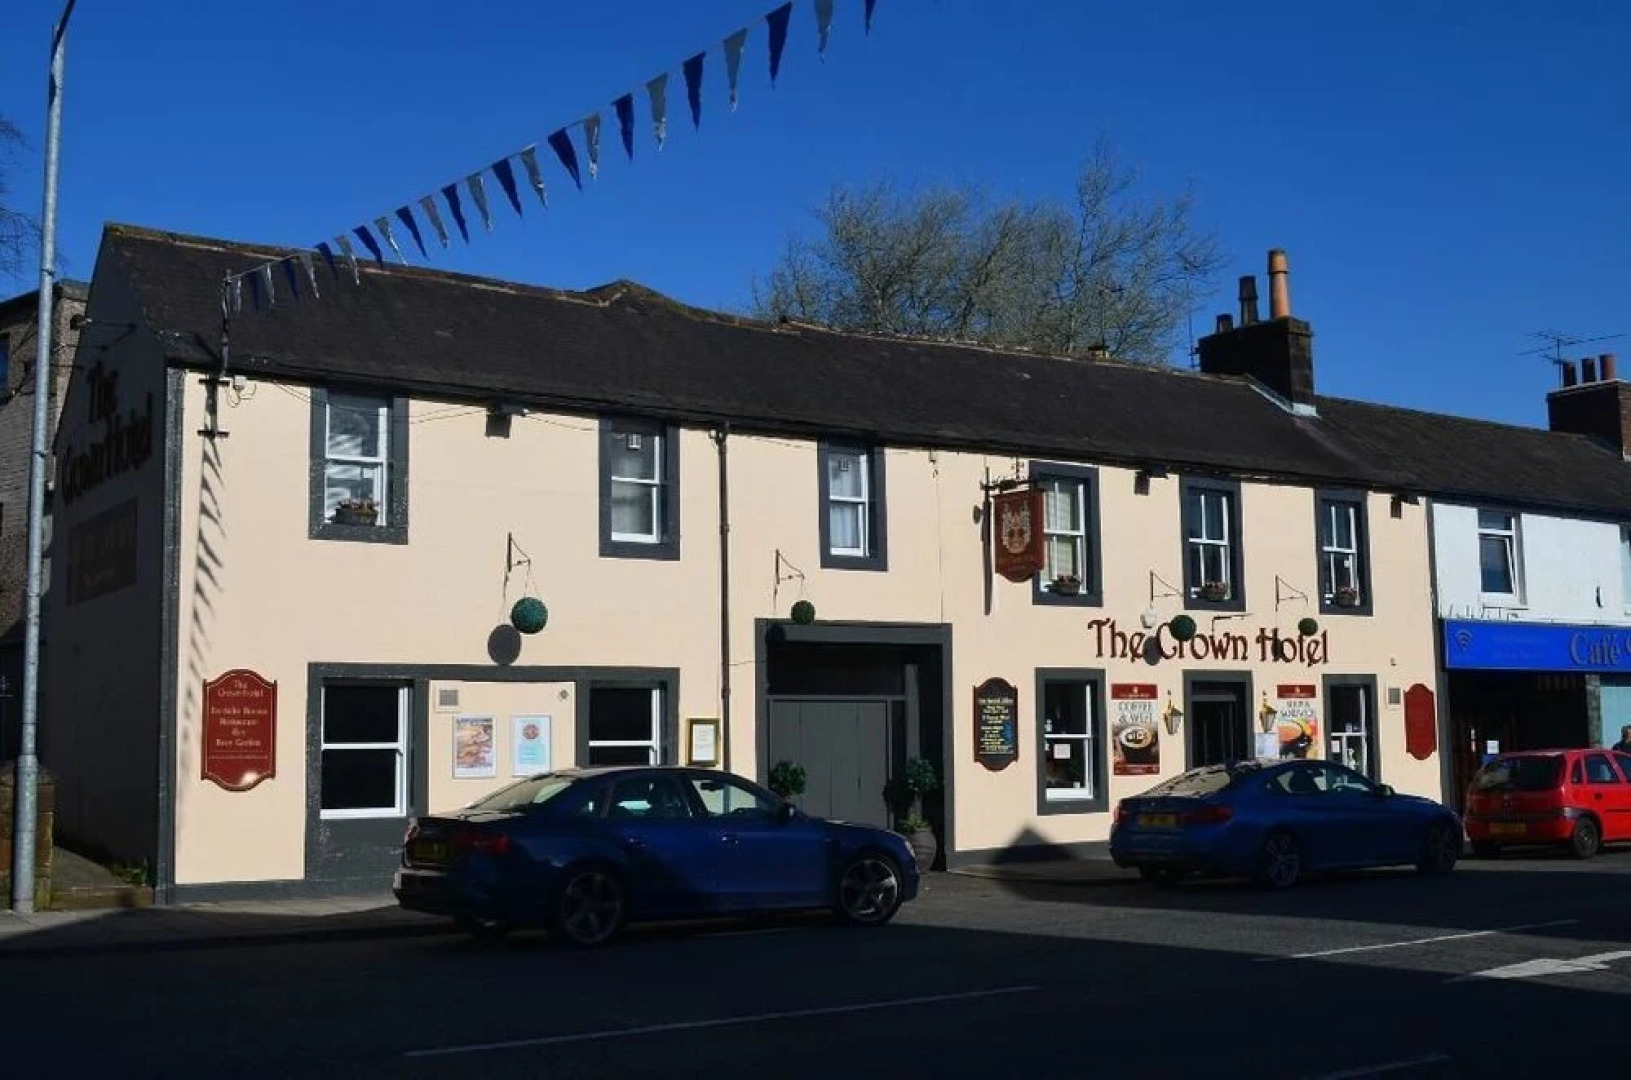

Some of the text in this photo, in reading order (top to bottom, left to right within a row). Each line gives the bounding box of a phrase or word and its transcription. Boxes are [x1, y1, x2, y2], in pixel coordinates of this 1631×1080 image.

[1087, 617, 1330, 667] The Crown Hotel
[1570, 632, 1619, 665] Café
